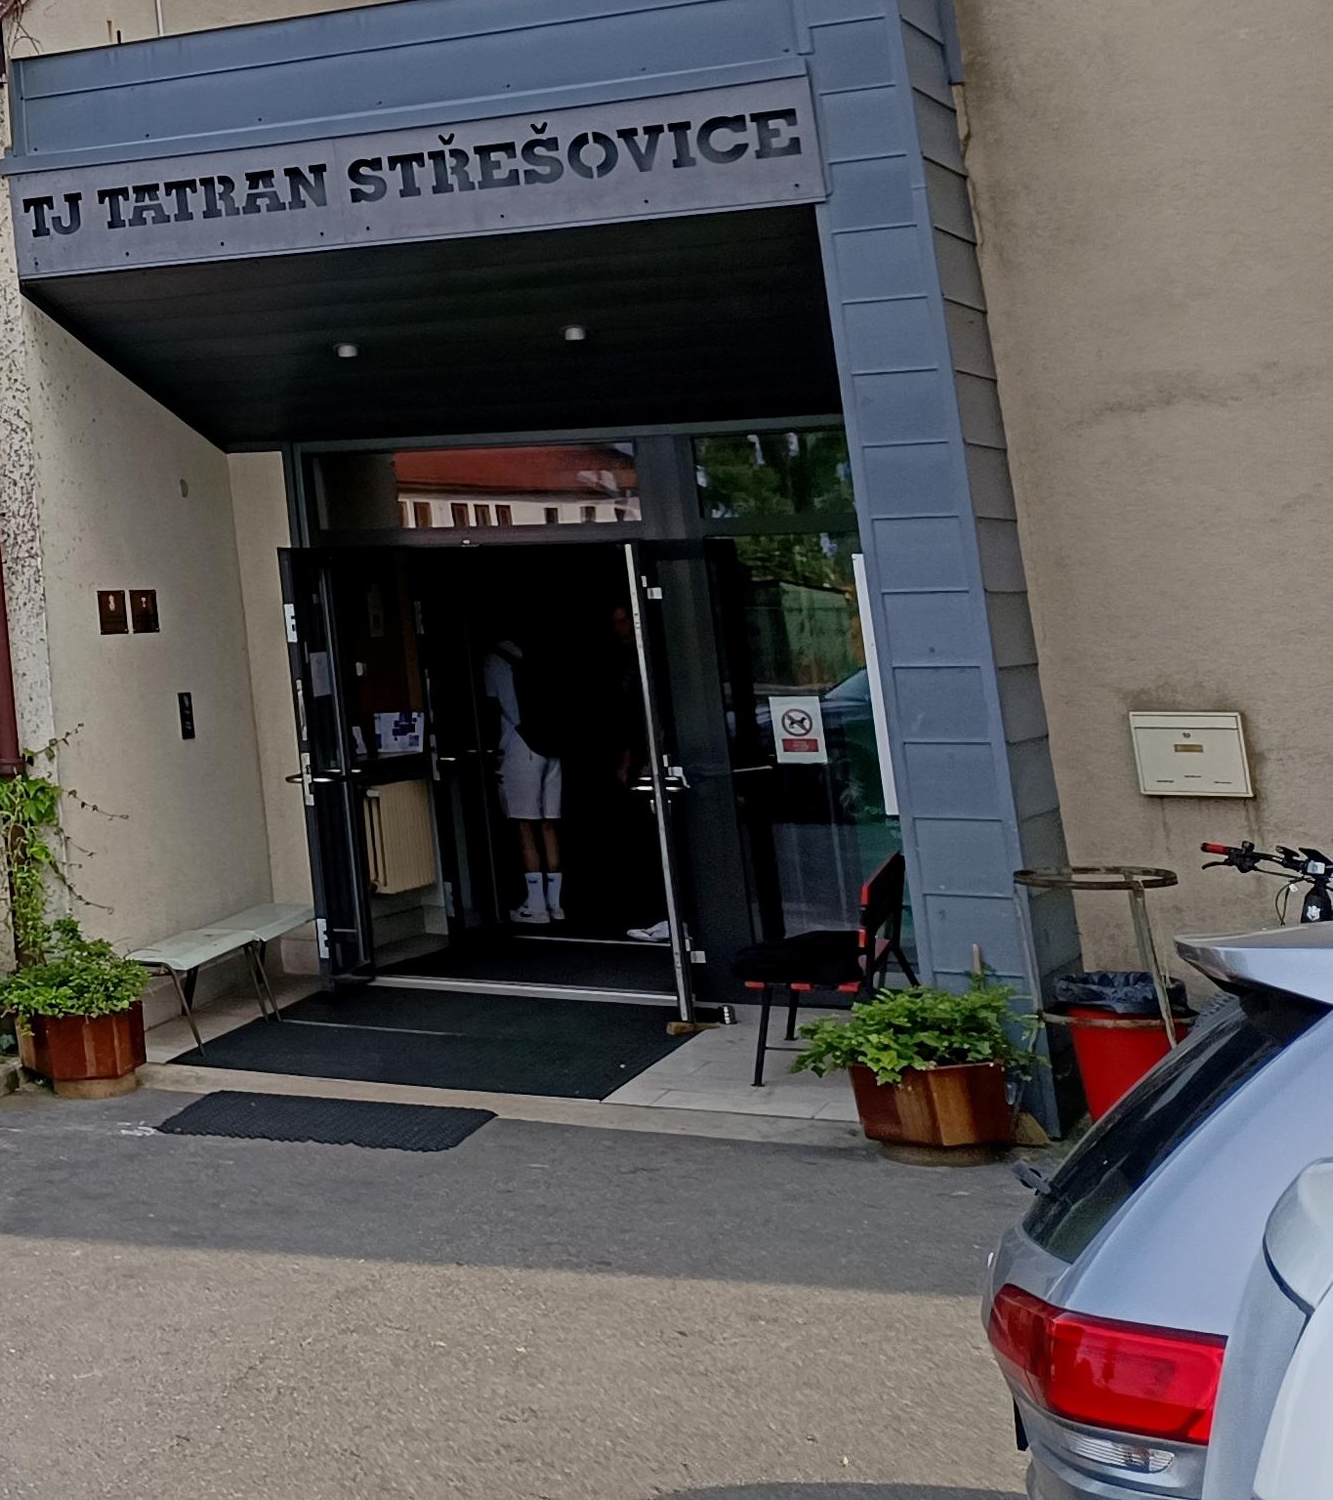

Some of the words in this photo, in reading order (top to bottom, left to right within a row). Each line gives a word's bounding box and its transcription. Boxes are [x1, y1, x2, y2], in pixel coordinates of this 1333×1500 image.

[23, 191, 82, 238] TJ
[98, 161, 329, 231] TATRAN
[348, 107, 801, 204] STŘEŠOVICE
